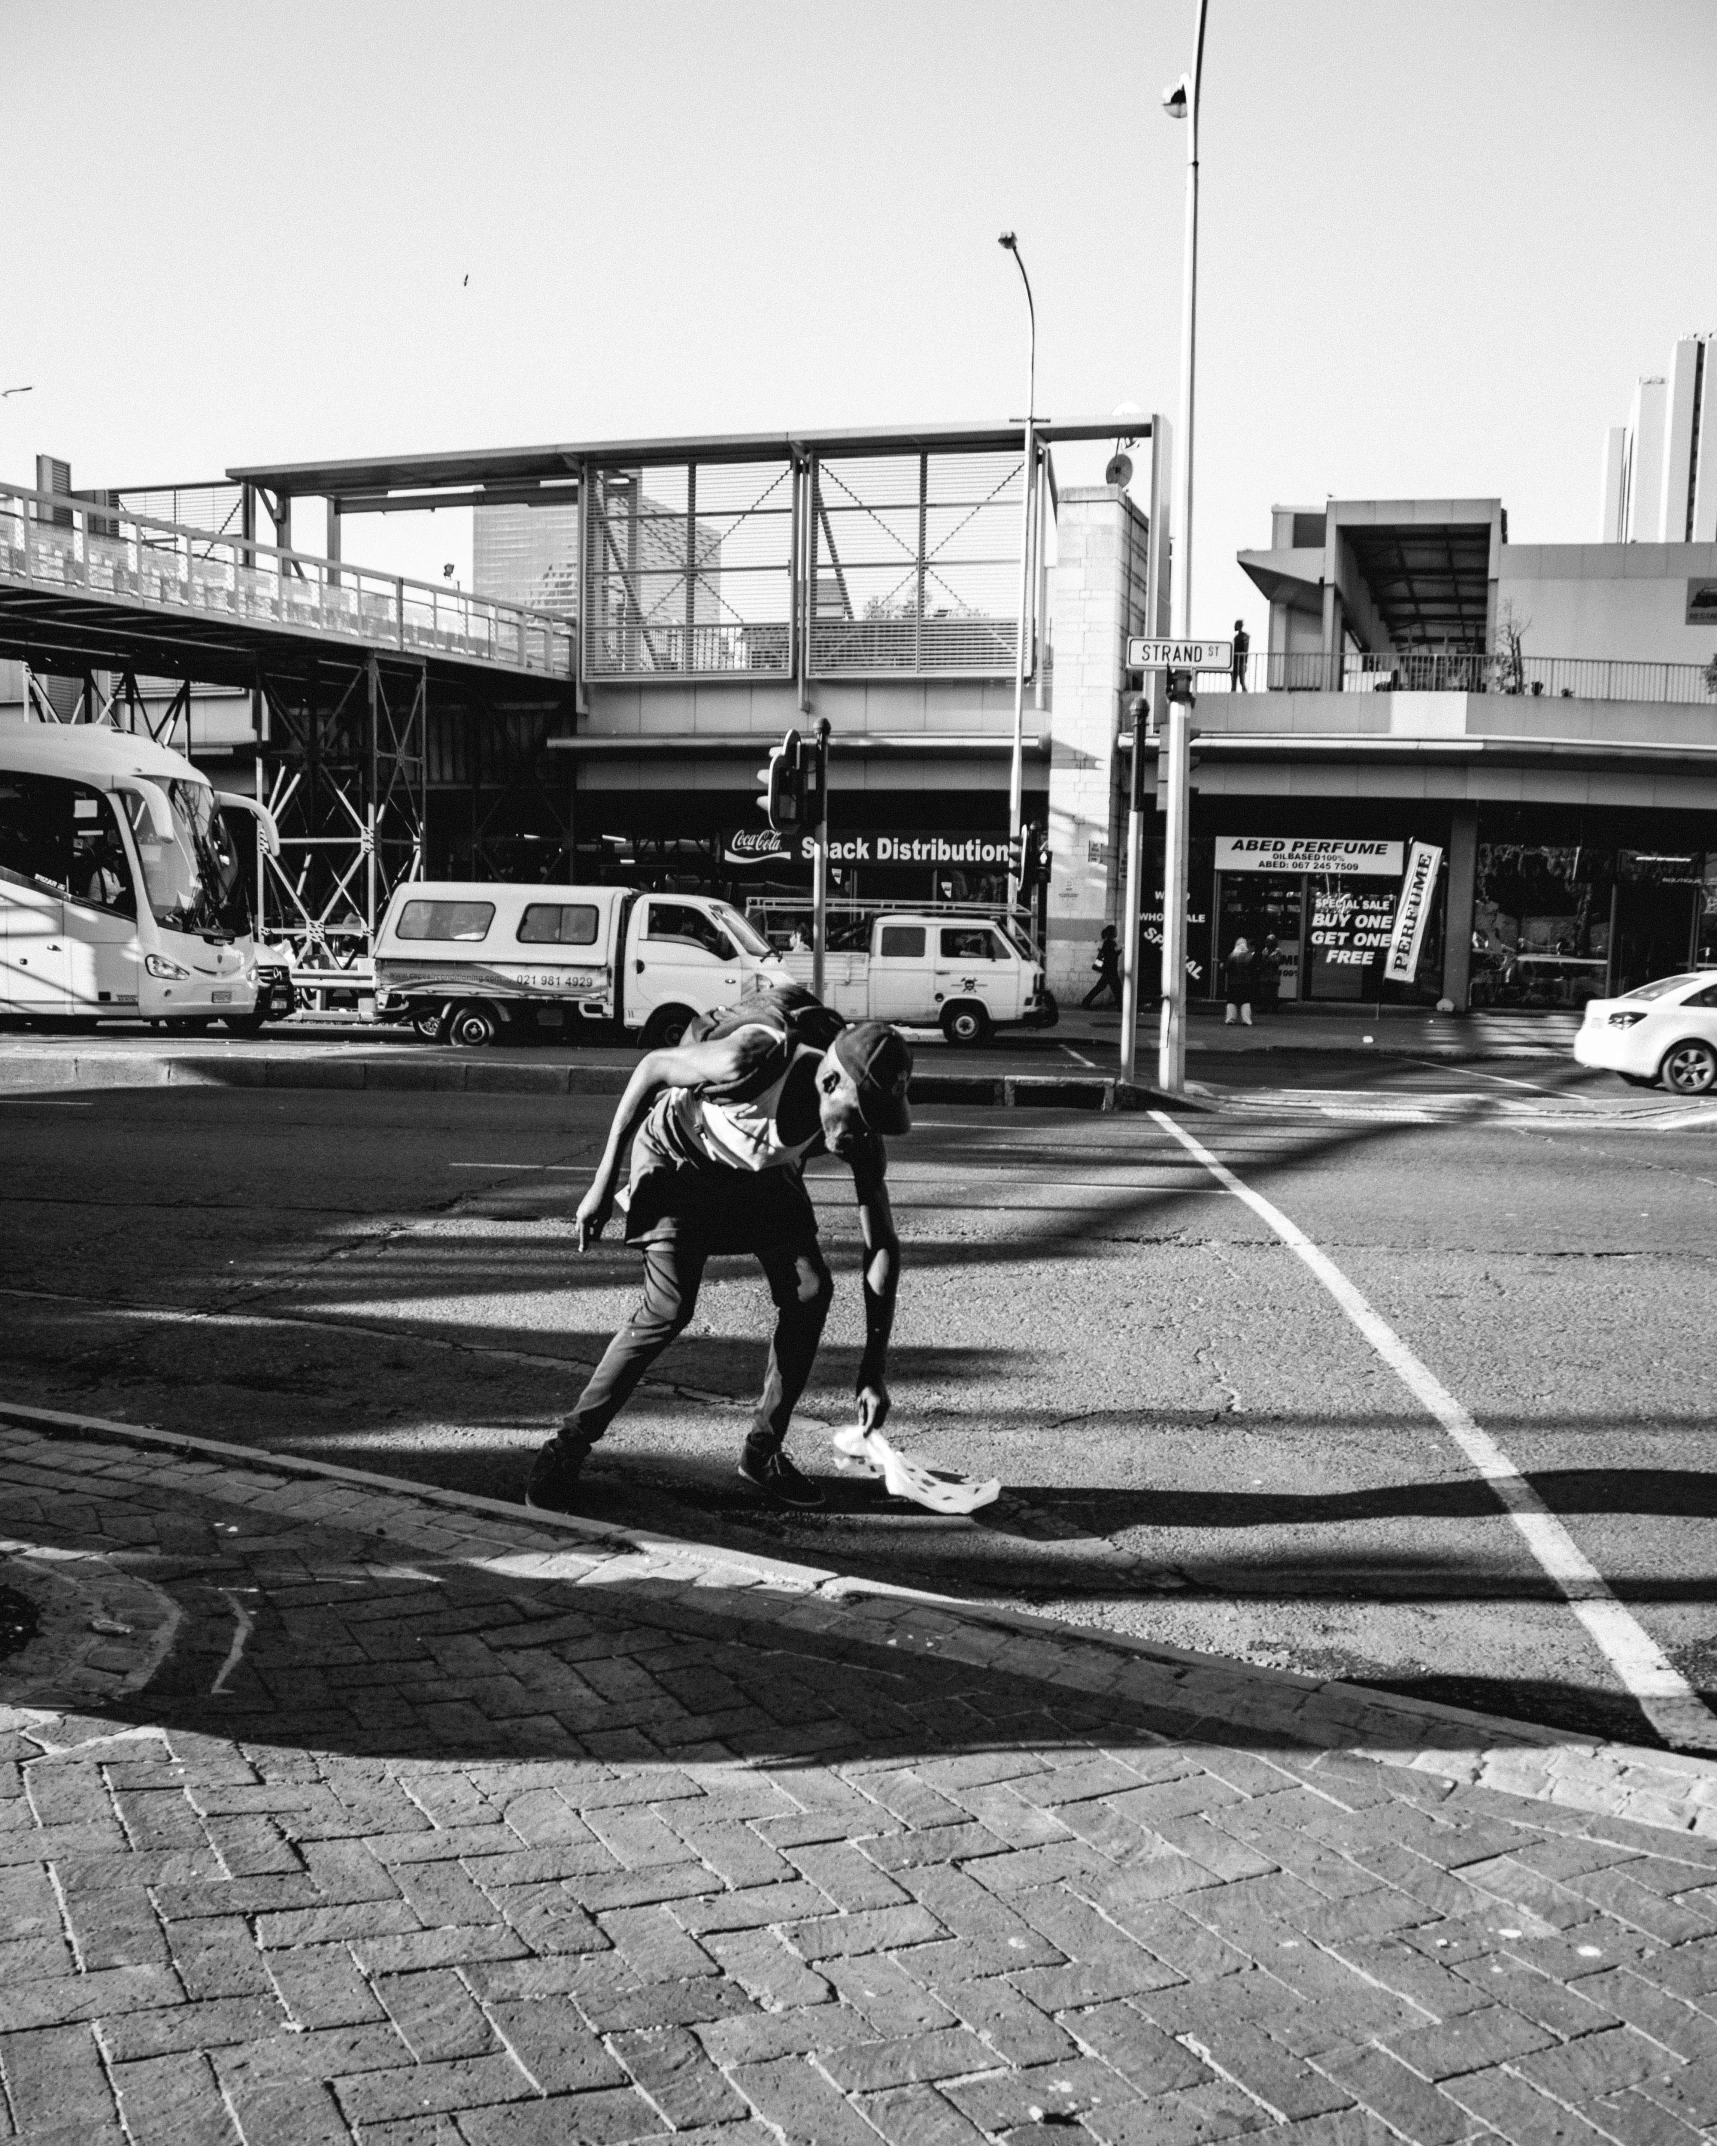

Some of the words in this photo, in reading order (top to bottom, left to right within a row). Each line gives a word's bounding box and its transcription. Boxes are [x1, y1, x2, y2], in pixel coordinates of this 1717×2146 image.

[1142, 644, 1203, 663] STRAND
[1208, 646, 1219, 656] ST
[801, 836, 870, 859] Sack
[877, 837, 1009, 861] Distribution
[1231, 839, 1286, 852] ABED
[1291, 841, 1389, 855] PERFUME
[1258, 860, 1289, 869] ABED:
[1292, 861, 1310, 869] 067
[1313, 862, 1331, 870] 245
[1334, 862, 1359, 871] 7509
[1315, 899, 1360, 909] SPECIAL
[1362, 900, 1390, 910] SALE
[1393, 853, 1432, 972] PERFUME
[1312, 912, 1351, 927] BUY
[1355, 914, 1394, 929] ONE
[1311, 930, 1350, 945] GET
[1353, 932, 1393, 947] ONE
[1326, 949, 1375, 965] FREE
[516, 975, 536, 985] 021
[540, 976, 560, 986] 981
[565, 976, 593, 988] 4929
